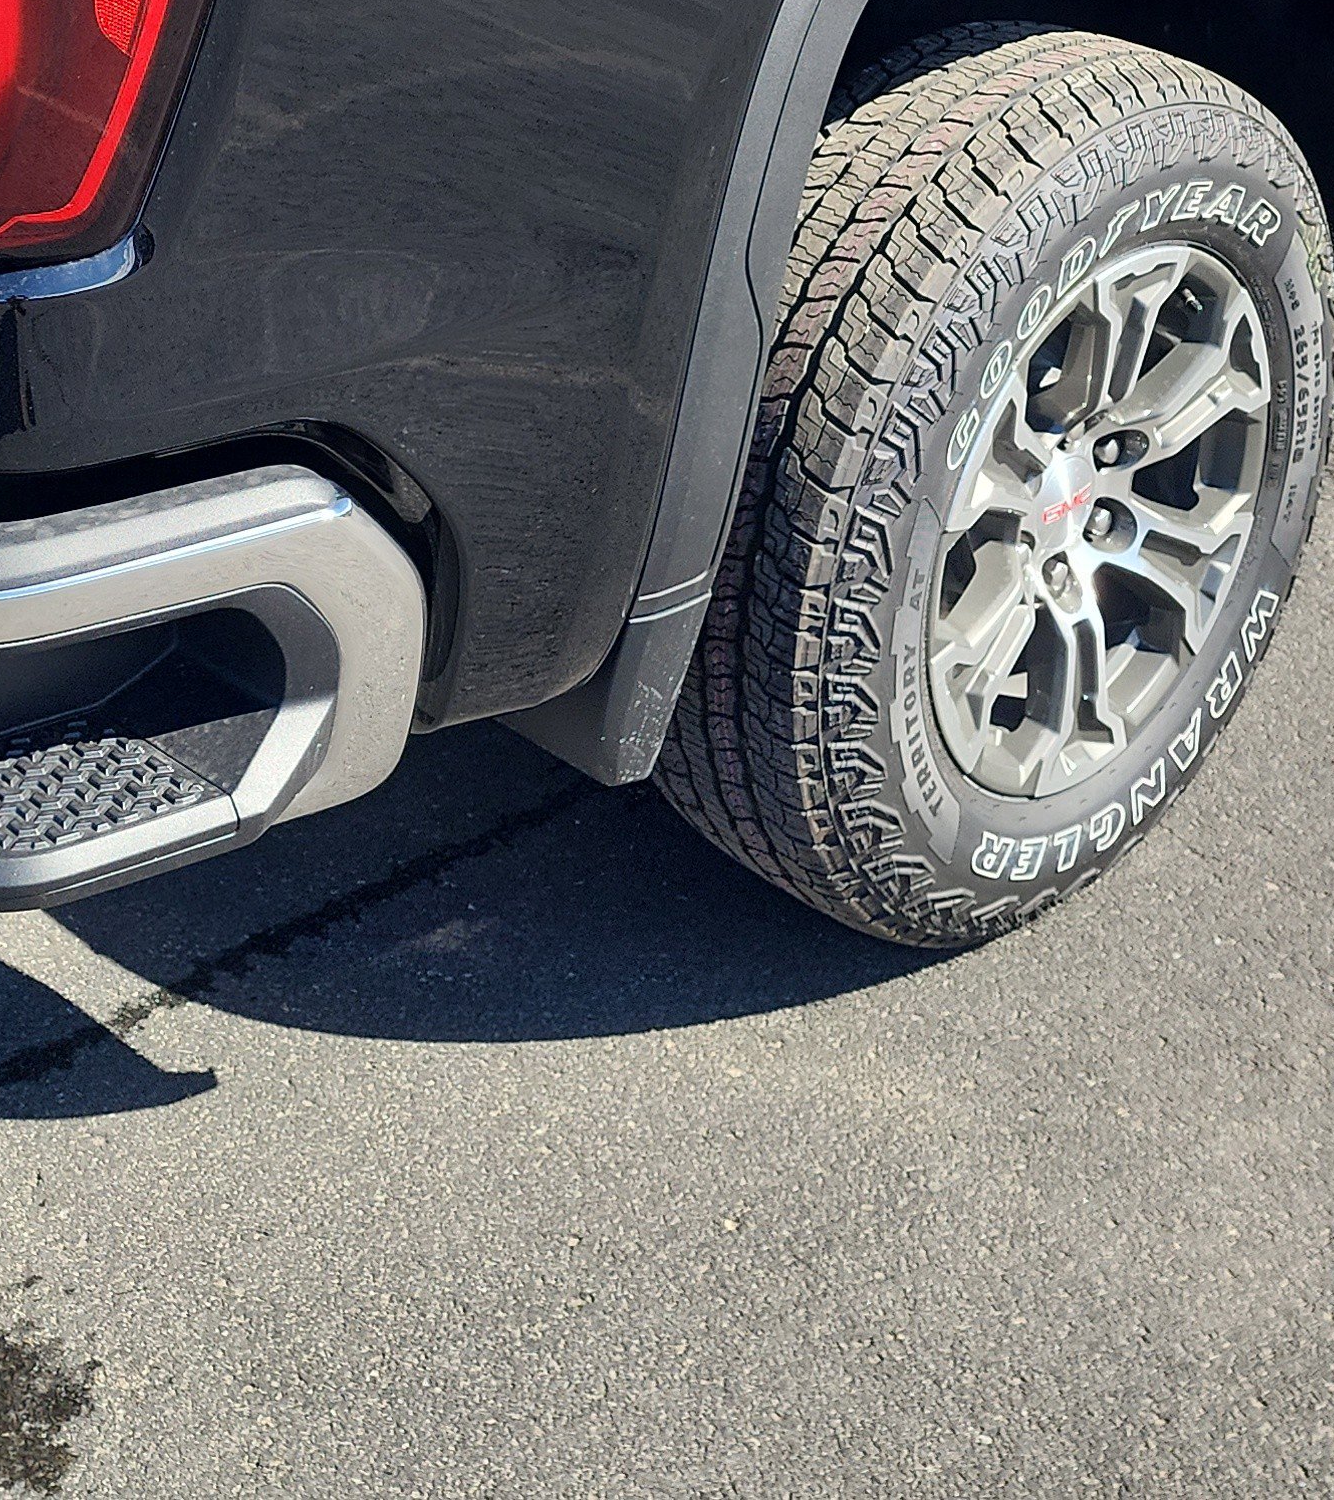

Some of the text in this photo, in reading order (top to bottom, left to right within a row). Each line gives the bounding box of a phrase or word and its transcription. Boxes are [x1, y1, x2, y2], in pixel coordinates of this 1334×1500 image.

[946, 180, 1283, 471] GOODYEAR
[903, 568, 943, 818] TERRITORY AT
[970, 589, 1280, 882] WRANGLER
